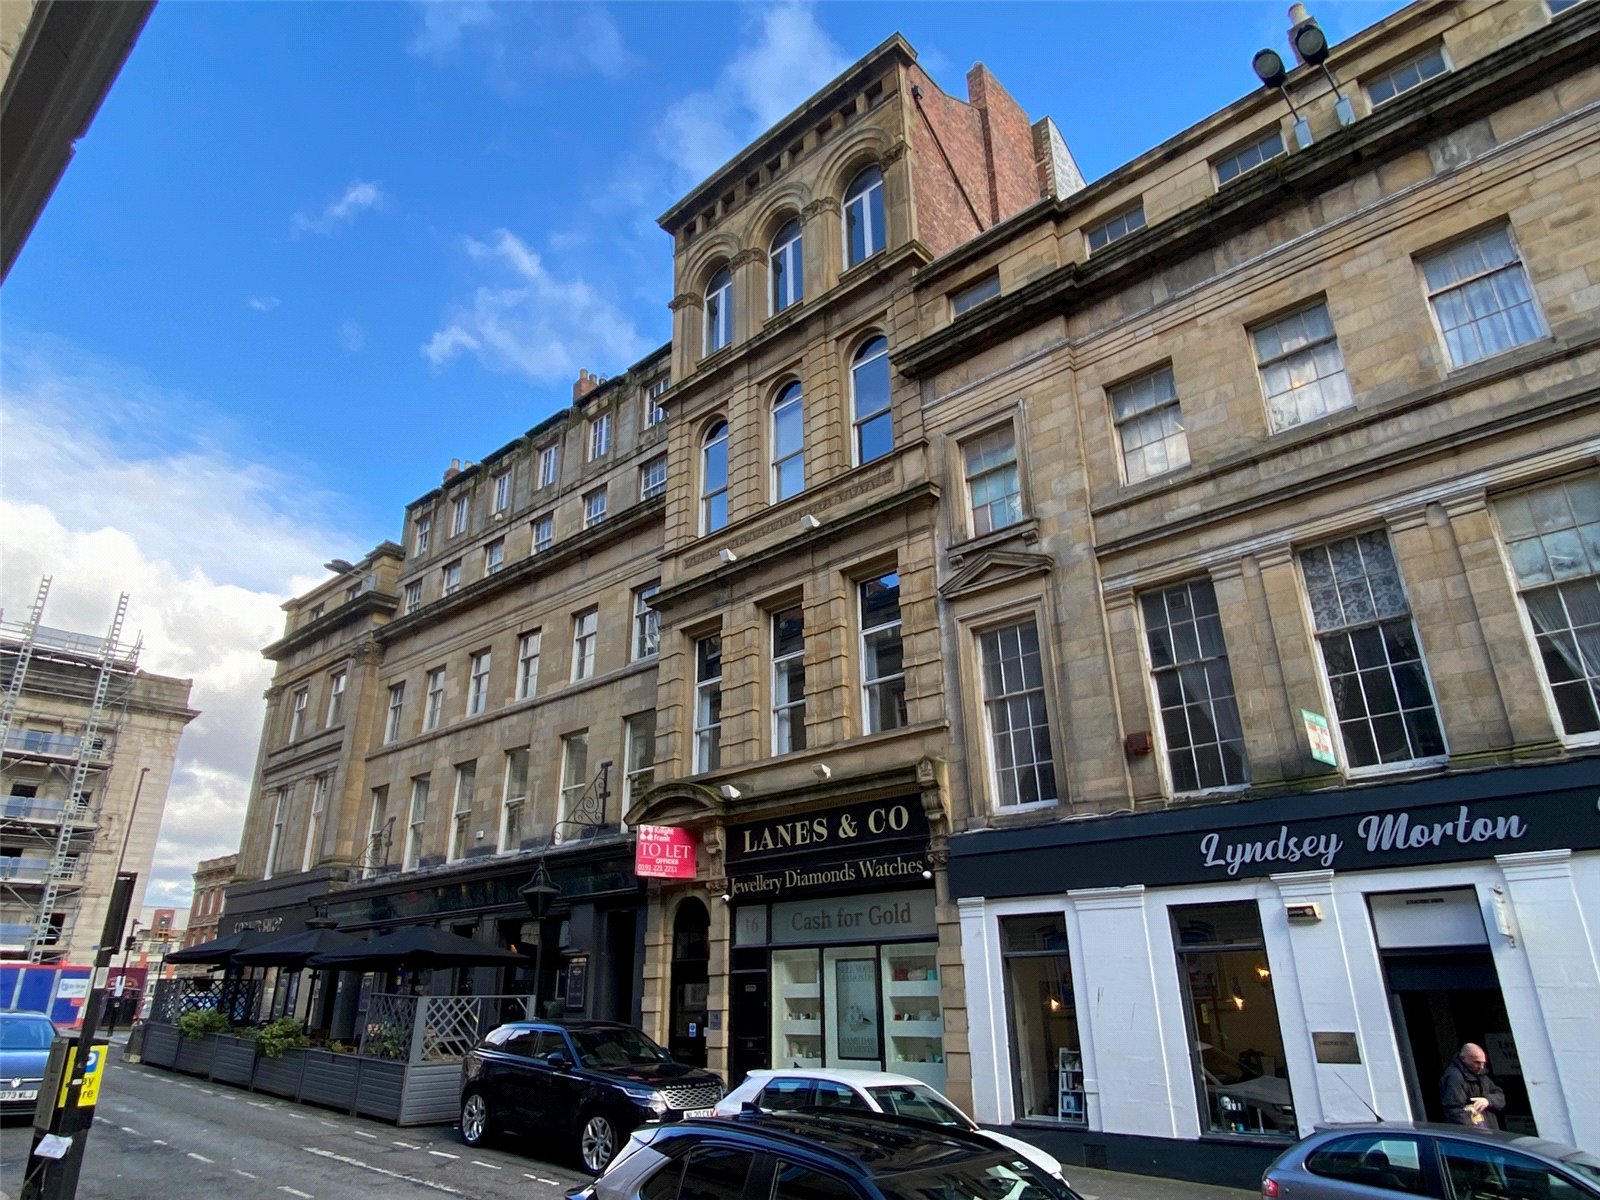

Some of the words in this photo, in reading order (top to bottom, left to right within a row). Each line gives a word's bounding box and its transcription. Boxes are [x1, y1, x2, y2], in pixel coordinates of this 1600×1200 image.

[743, 817, 829, 853] LANES
[838, 813, 858, 839] &
[868, 805, 910, 834] CO
[639, 842, 661, 857] TO
[666, 844, 691, 859] LET
[1200, 825, 1344, 876] Lyndsey
[1357, 805, 1528, 853] Morton
[728, 873, 783, 898] Jewellery
[785, 863, 856, 889] Diamonds
[859, 856, 923, 878] Watches
[745, 916, 759, 933] 16
[791, 908, 832, 931] Cash
[837, 907, 864, 928] for
[868, 903, 912, 926] Gold
[82, 1078, 95, 1087] ay
[82, 1090, 94, 1098] re
